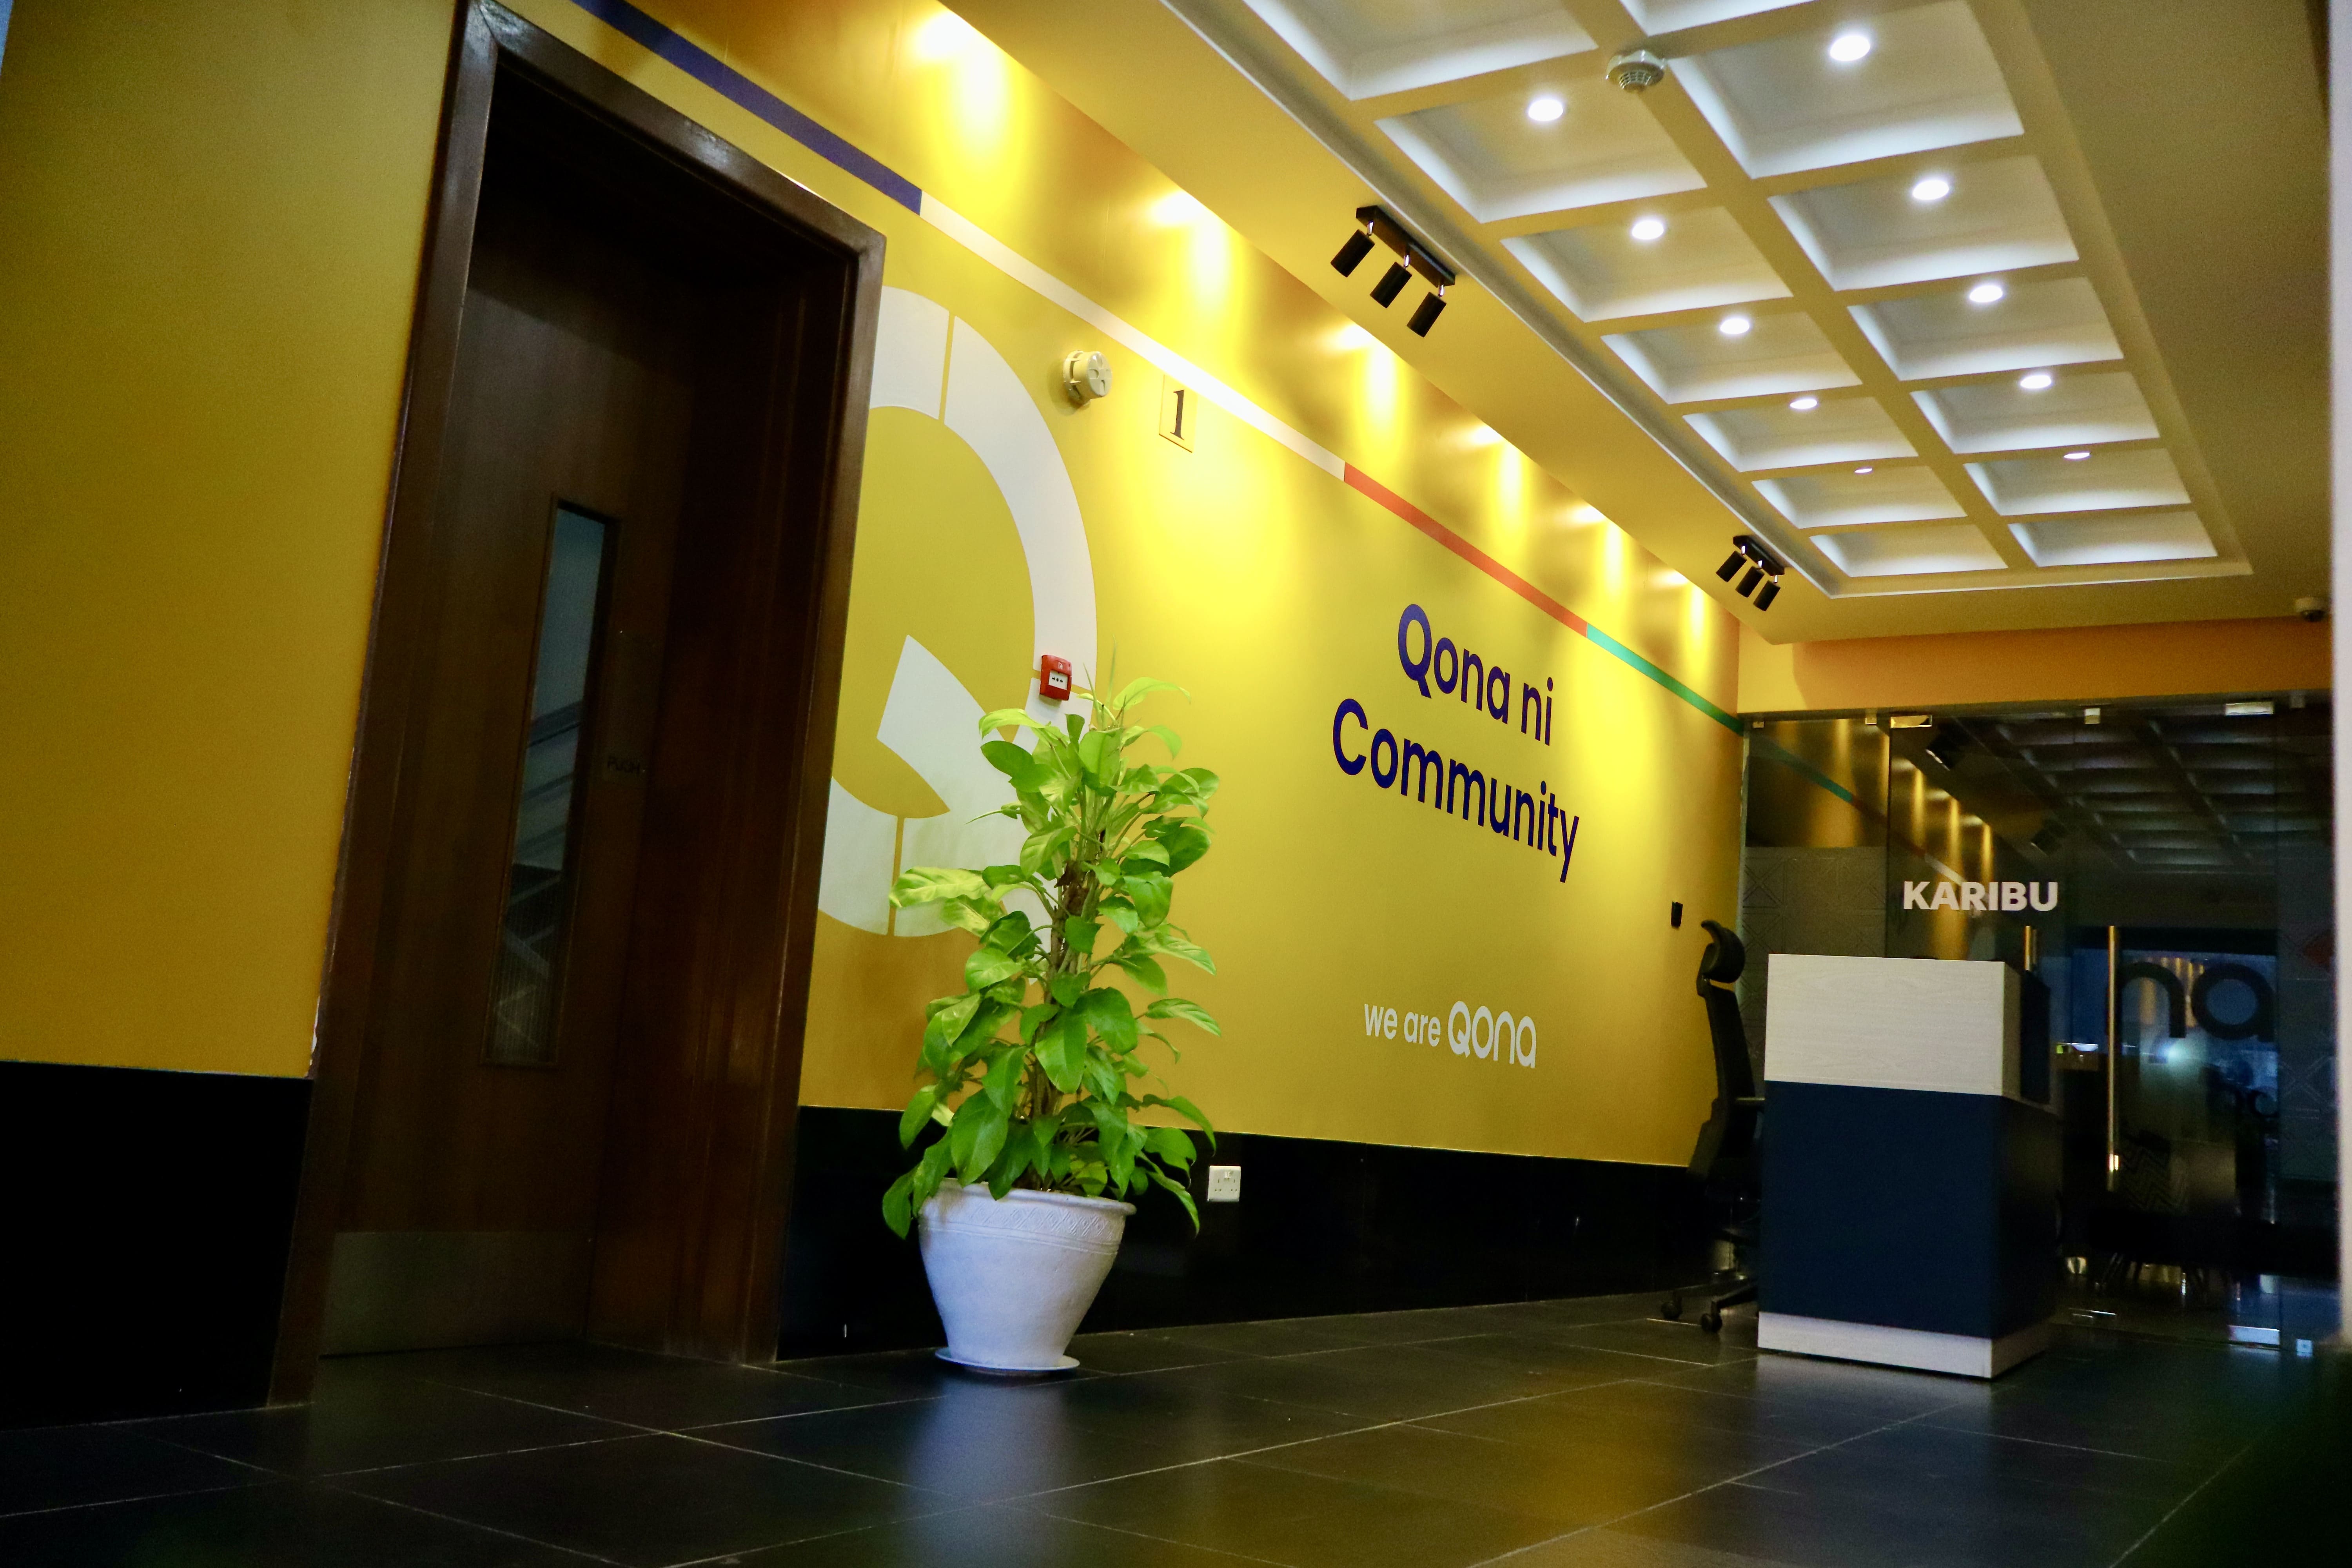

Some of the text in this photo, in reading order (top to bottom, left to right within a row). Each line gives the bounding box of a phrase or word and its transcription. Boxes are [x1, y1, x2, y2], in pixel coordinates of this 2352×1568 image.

[1170, 389, 1185, 441] 1
[1397, 604, 1553, 746] Qona ni
[607, 755, 640, 775] PUSH
[1332, 698, 1579, 884] Community
[1903, 881, 2058, 911] KARIBU
[1364, 1000, 1536, 1069] we are Qona
